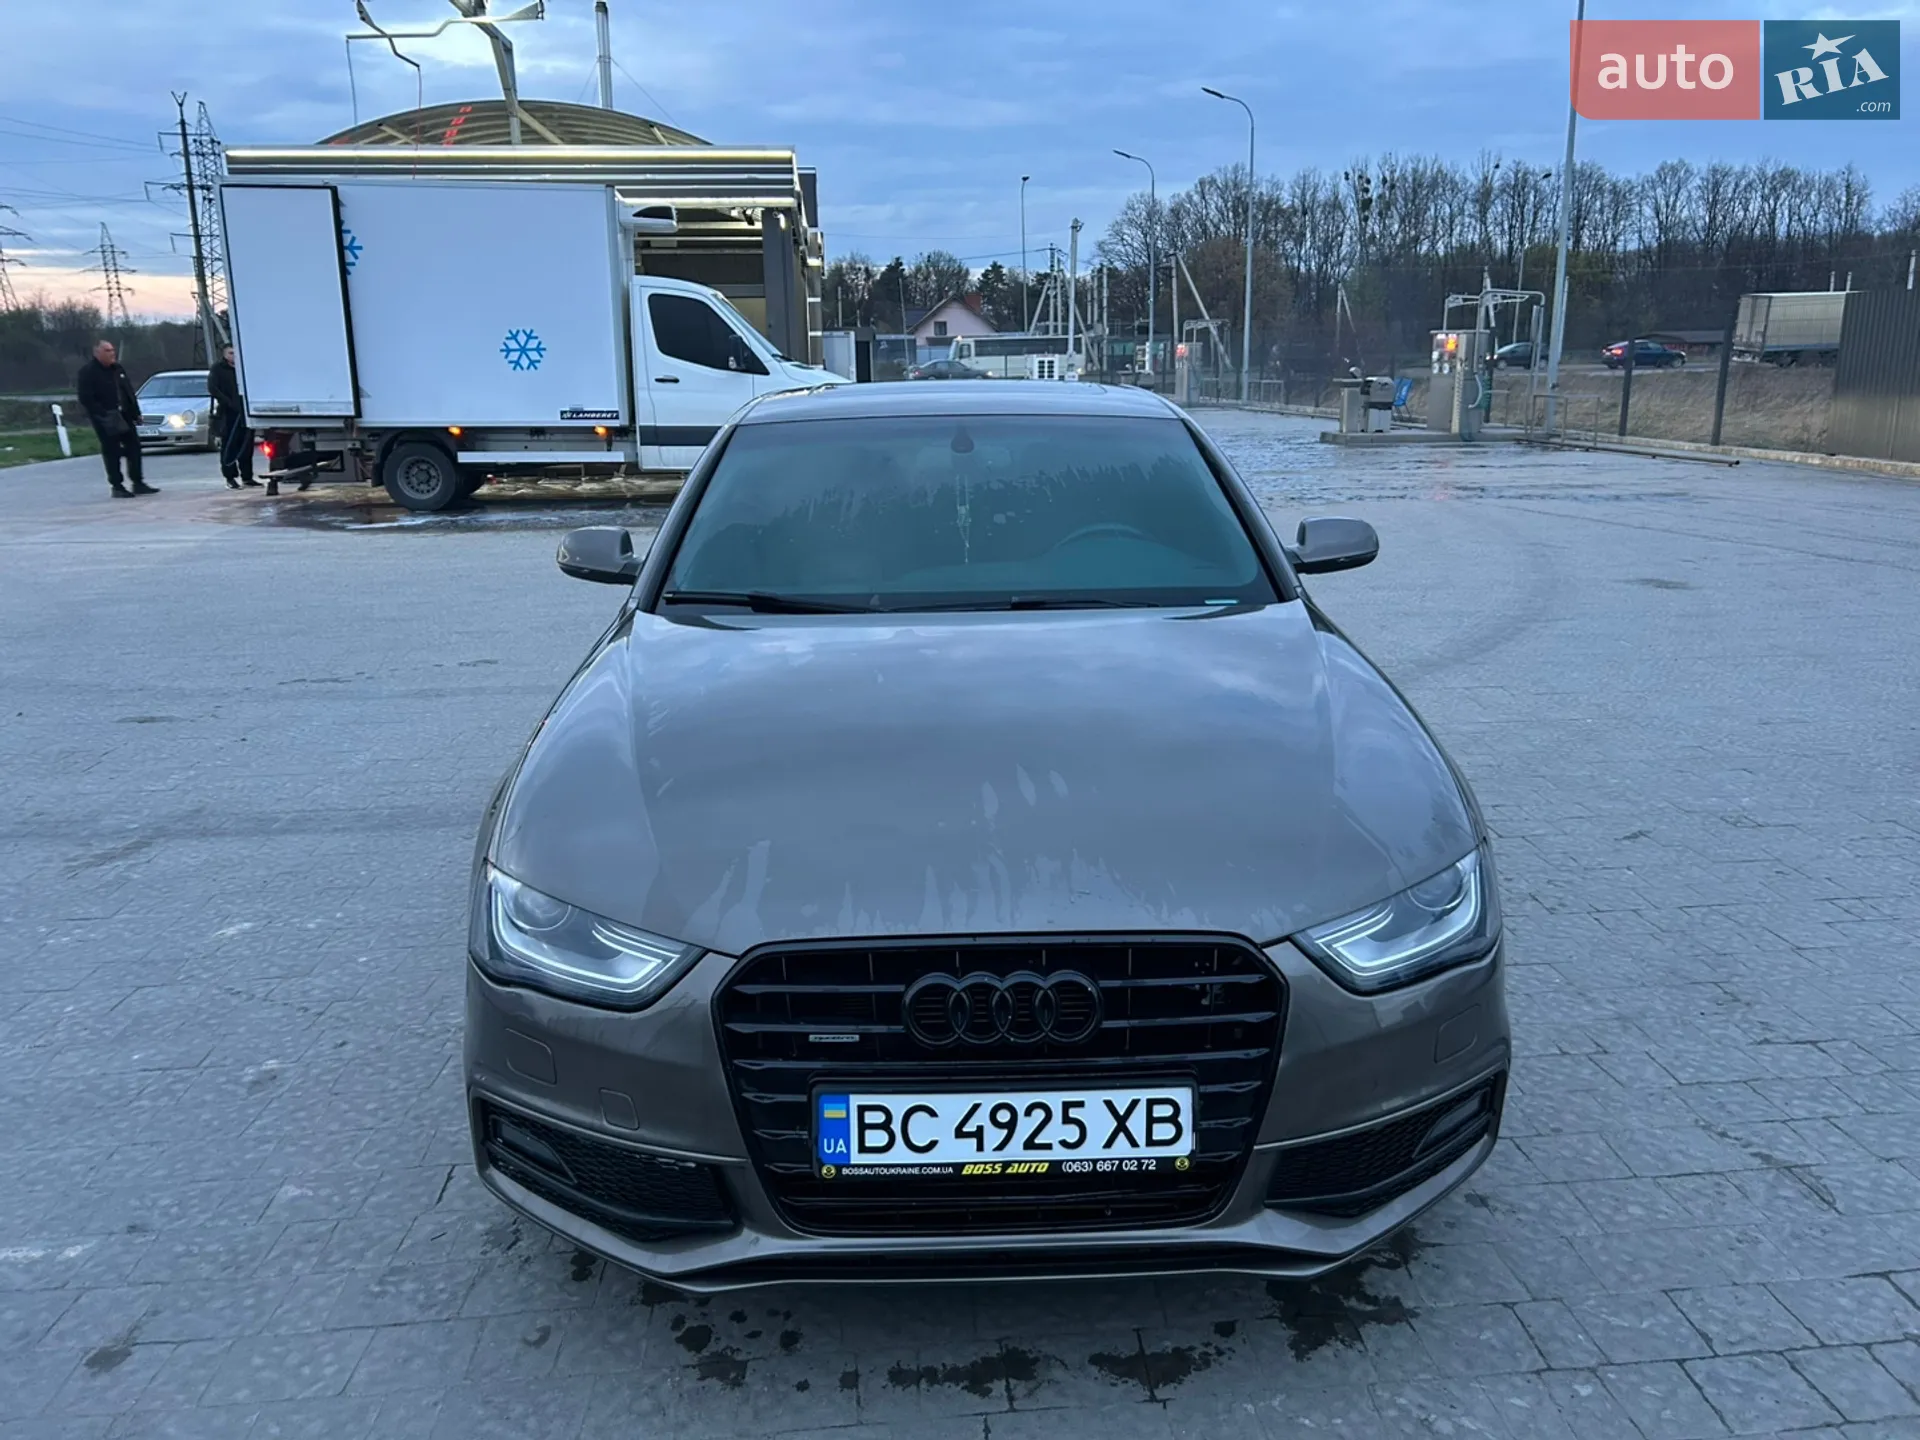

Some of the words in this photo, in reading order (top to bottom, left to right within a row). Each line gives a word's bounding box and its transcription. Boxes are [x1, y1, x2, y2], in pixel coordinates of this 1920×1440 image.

[856, 1103, 939, 1154] BC
[954, 1100, 1087, 1152] 4925
[1102, 1097, 1183, 1149] XB
[823, 1138, 847, 1154] UA
[842, 1166, 954, 1175] BOSSAUTOUKRAINE.COM.UA
[961, 1163, 1003, 1175] BOSS
[1005, 1162, 1049, 1174] AUTO
[1062, 1160, 1093, 1173] (063)
[1096, 1160, 1119, 1171] 667
[1122, 1160, 1139, 1171] 02
[1141, 1159, 1157, 1170] 72
